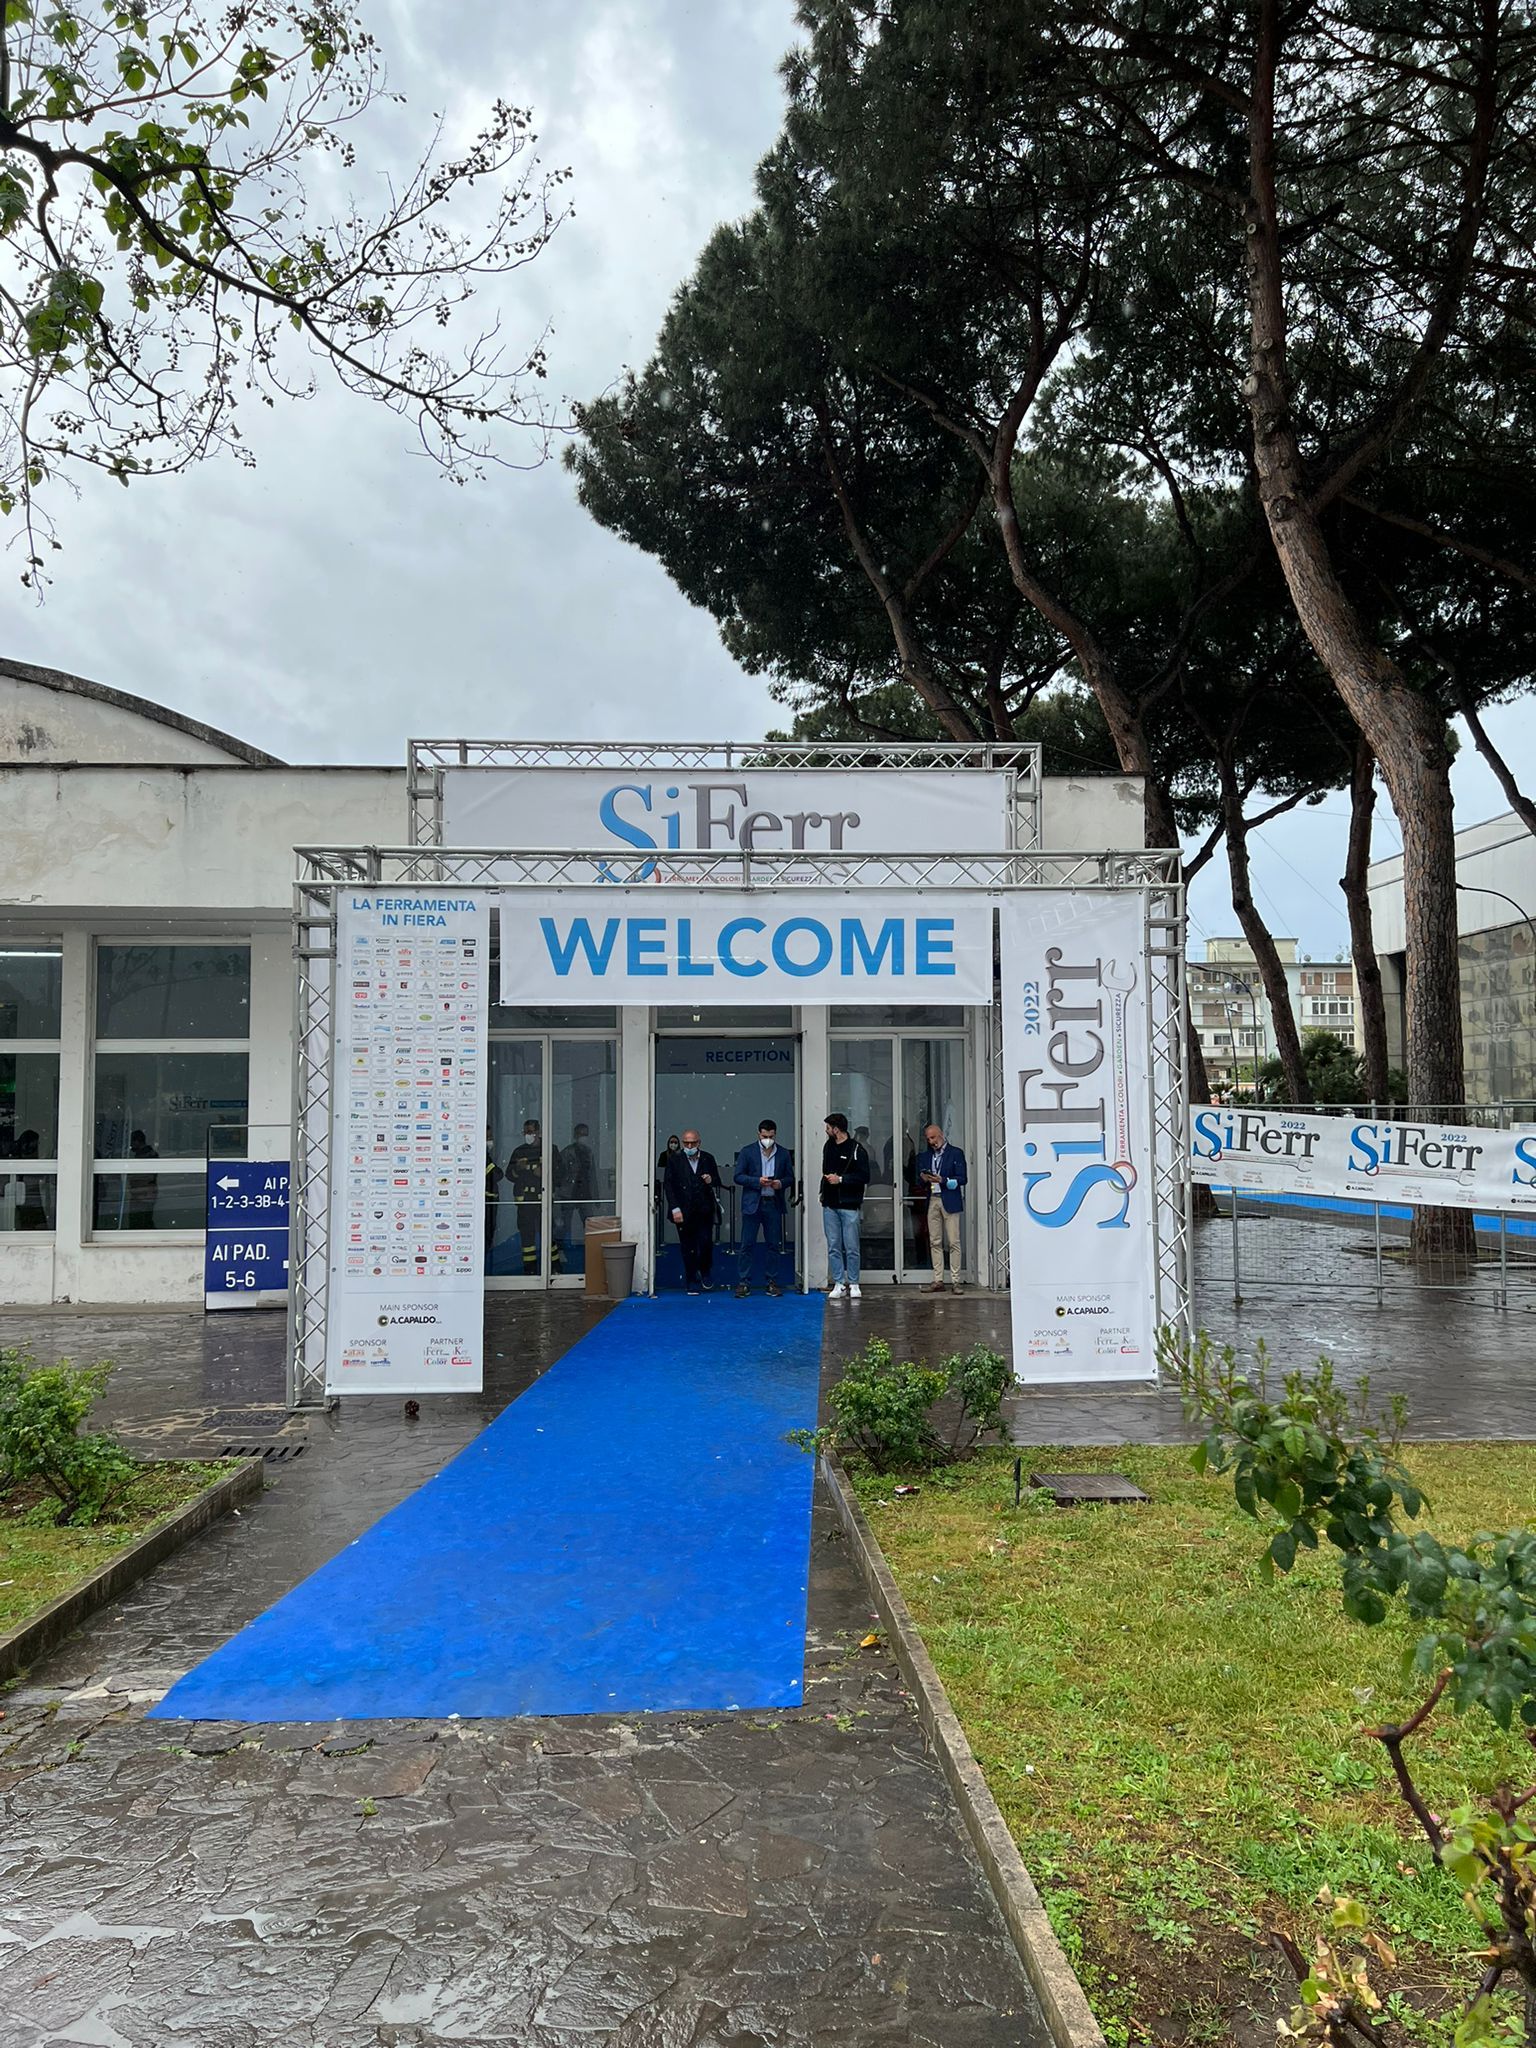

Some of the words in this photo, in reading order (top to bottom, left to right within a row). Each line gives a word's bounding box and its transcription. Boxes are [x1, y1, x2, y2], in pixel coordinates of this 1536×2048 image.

[353, 898, 372, 910] LA
[376, 898, 477, 912] FERRAMENTA
[382, 914, 399, 926] IN
[403, 914, 447, 927] FIERA
[539, 917, 957, 977] WELCOME
[1023, 981, 1041, 1036] 2022
[1114, 992, 1122, 1033] SICUREZZA
[705, 1050, 790, 1062] RECEPTION
[1018, 947, 1131, 1229] SiFerr
[1117, 1075, 1125, 1104] COLORI
[1280, 1120, 1306, 1130] 2022
[1118, 1109, 1126, 1158] FERRAMENTA
[1192, 1111, 1320, 1159] SiFerr
[1441, 1133, 1467, 1143] 2022
[1348, 1124, 1483, 1173] SiFerr
[264, 1177, 276, 1190] AI
[212, 1244, 228, 1261] AI
[233, 1243, 270, 1261] PAD.
[225, 1271, 256, 1287] 5-6
[1077, 1294, 1111, 1302] SPONSOR
[402, 1303, 439, 1311] SPONSOR
[1067, 1306, 1109, 1315] A.CAPALDO
[390, 1316, 436, 1325] A.CAPALDO
[1100, 1327, 1130, 1335] PARTNER
[350, 1339, 387, 1347] SPONSOR
[430, 1337, 464, 1345] PARTNER
